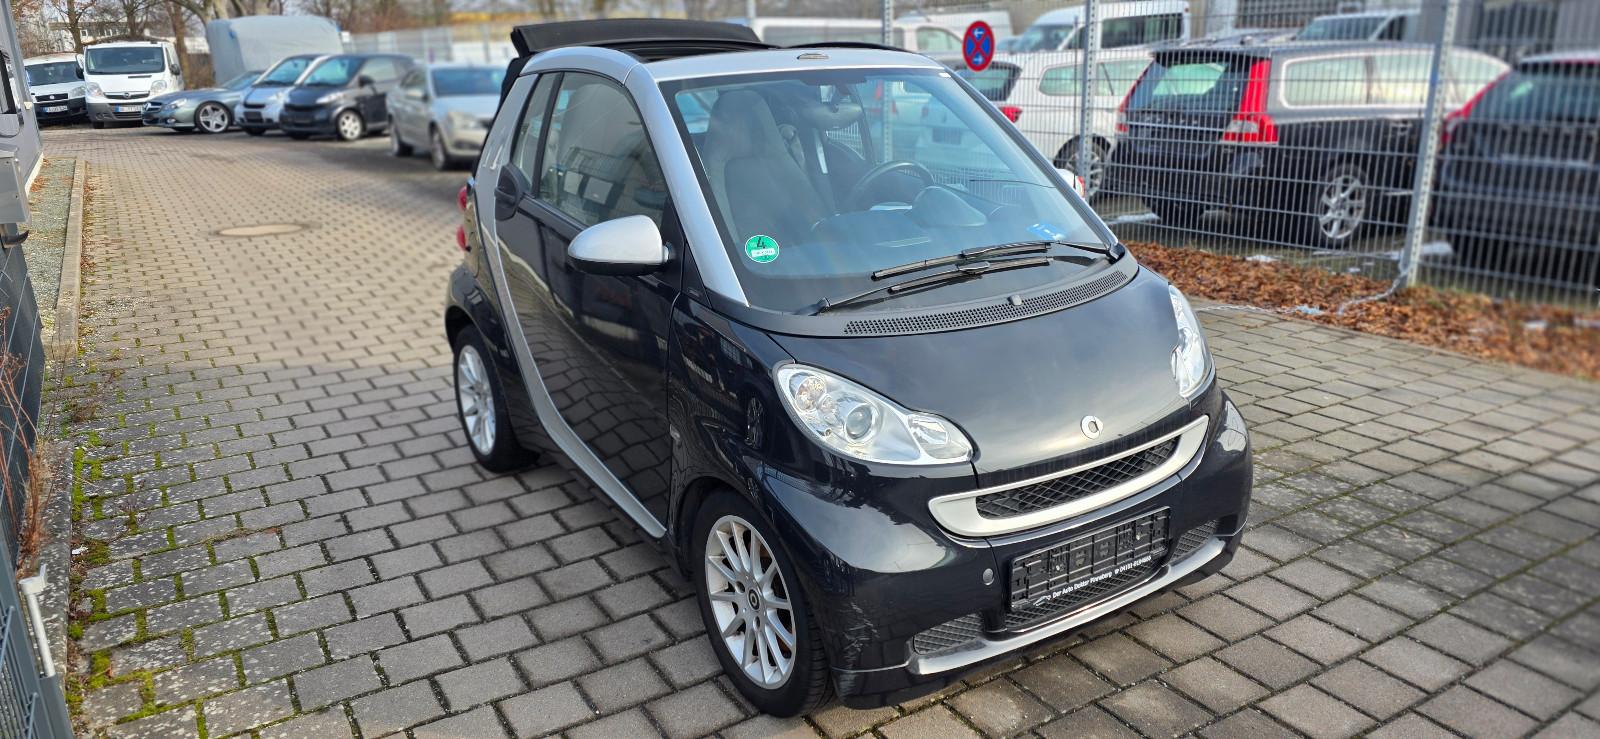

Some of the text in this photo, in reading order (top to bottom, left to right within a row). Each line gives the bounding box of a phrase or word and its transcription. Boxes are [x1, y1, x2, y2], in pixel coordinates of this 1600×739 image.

[757, 236, 766, 249] 4
[1062, 586, 1074, 595] Auto
[1074, 580, 1090, 590] Doktor
[1090, 571, 1113, 584] Pinneberg
